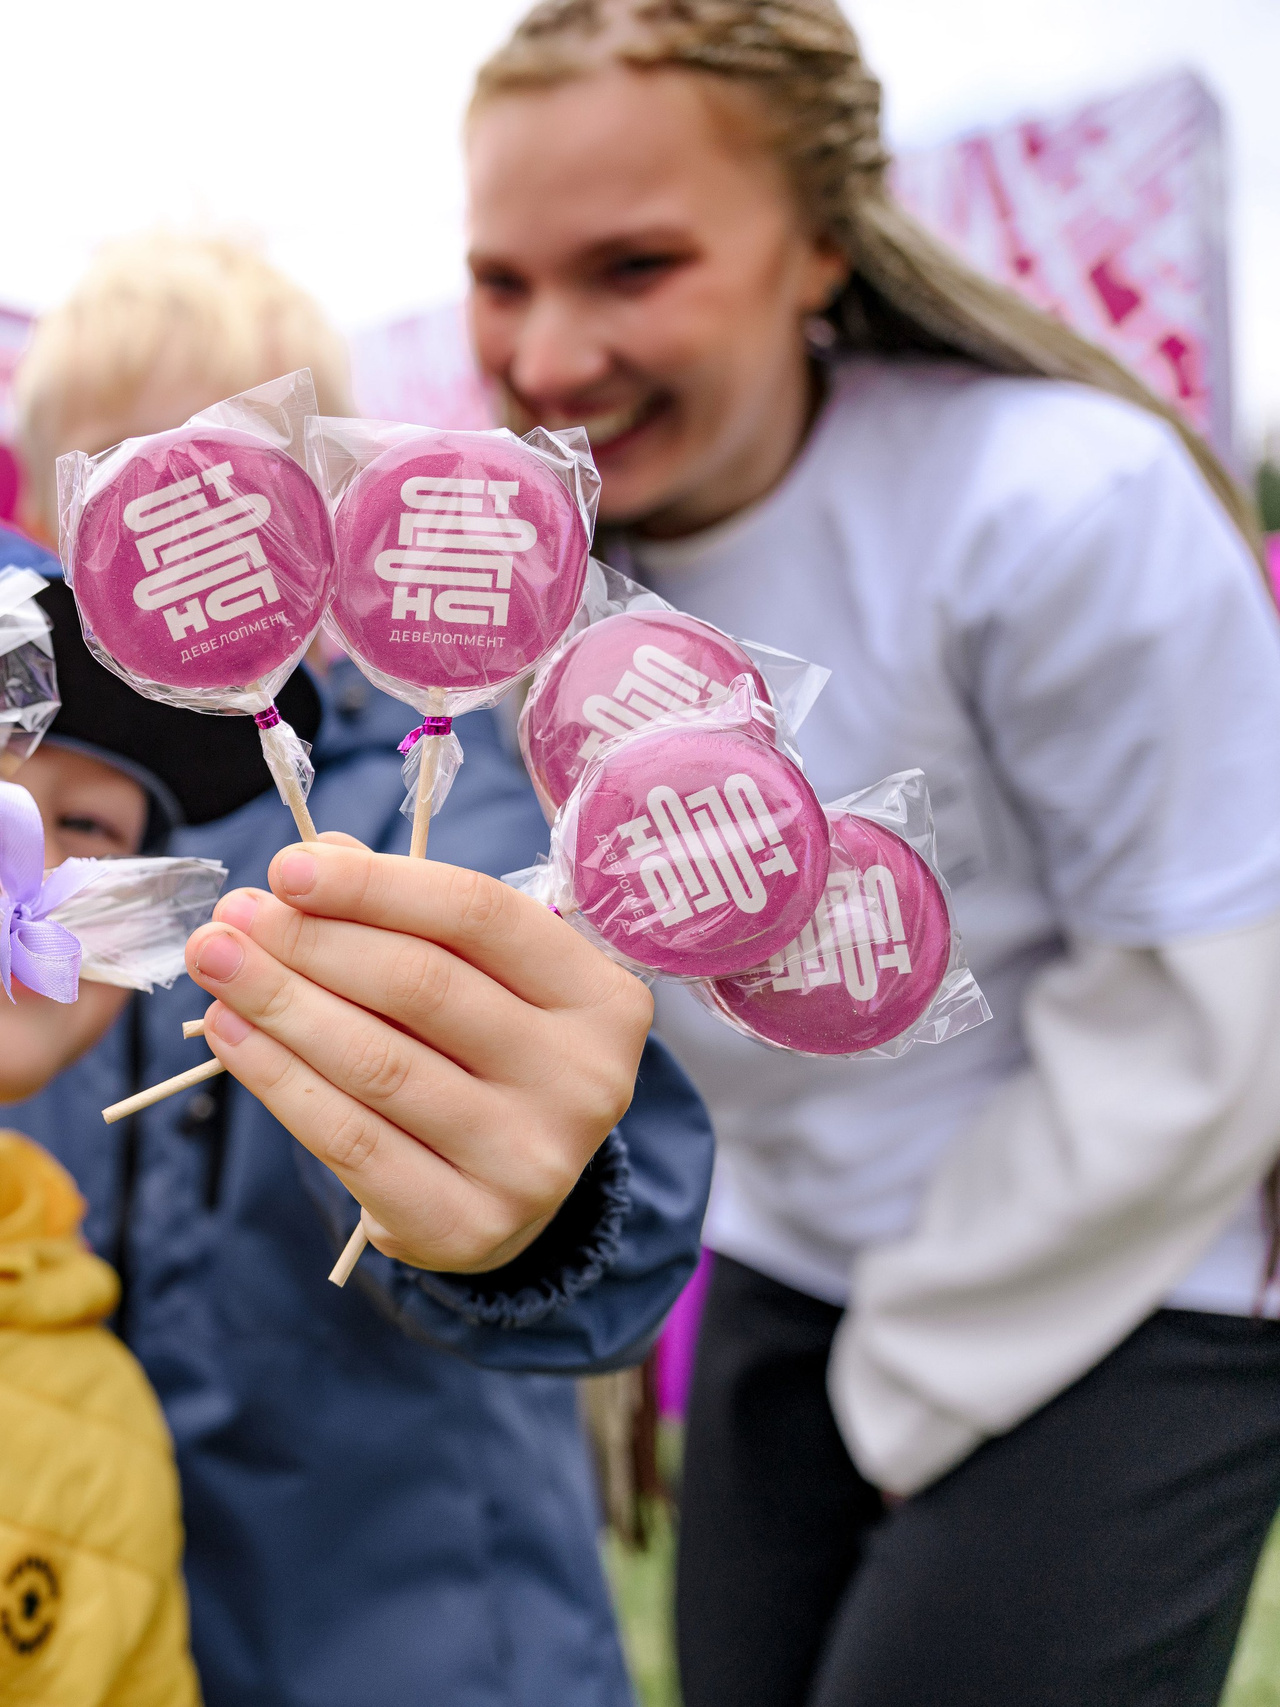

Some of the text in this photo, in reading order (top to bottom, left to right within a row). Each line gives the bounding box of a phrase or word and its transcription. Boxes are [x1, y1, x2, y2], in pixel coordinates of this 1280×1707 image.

[180, 610, 288, 664] ДЕВЕЛОПМЕНТ
[389, 630, 507, 649] ДЕВЕЛОПМЕНТ
[595, 833, 654, 936] ДЕВЕЛОПМЕНТ
